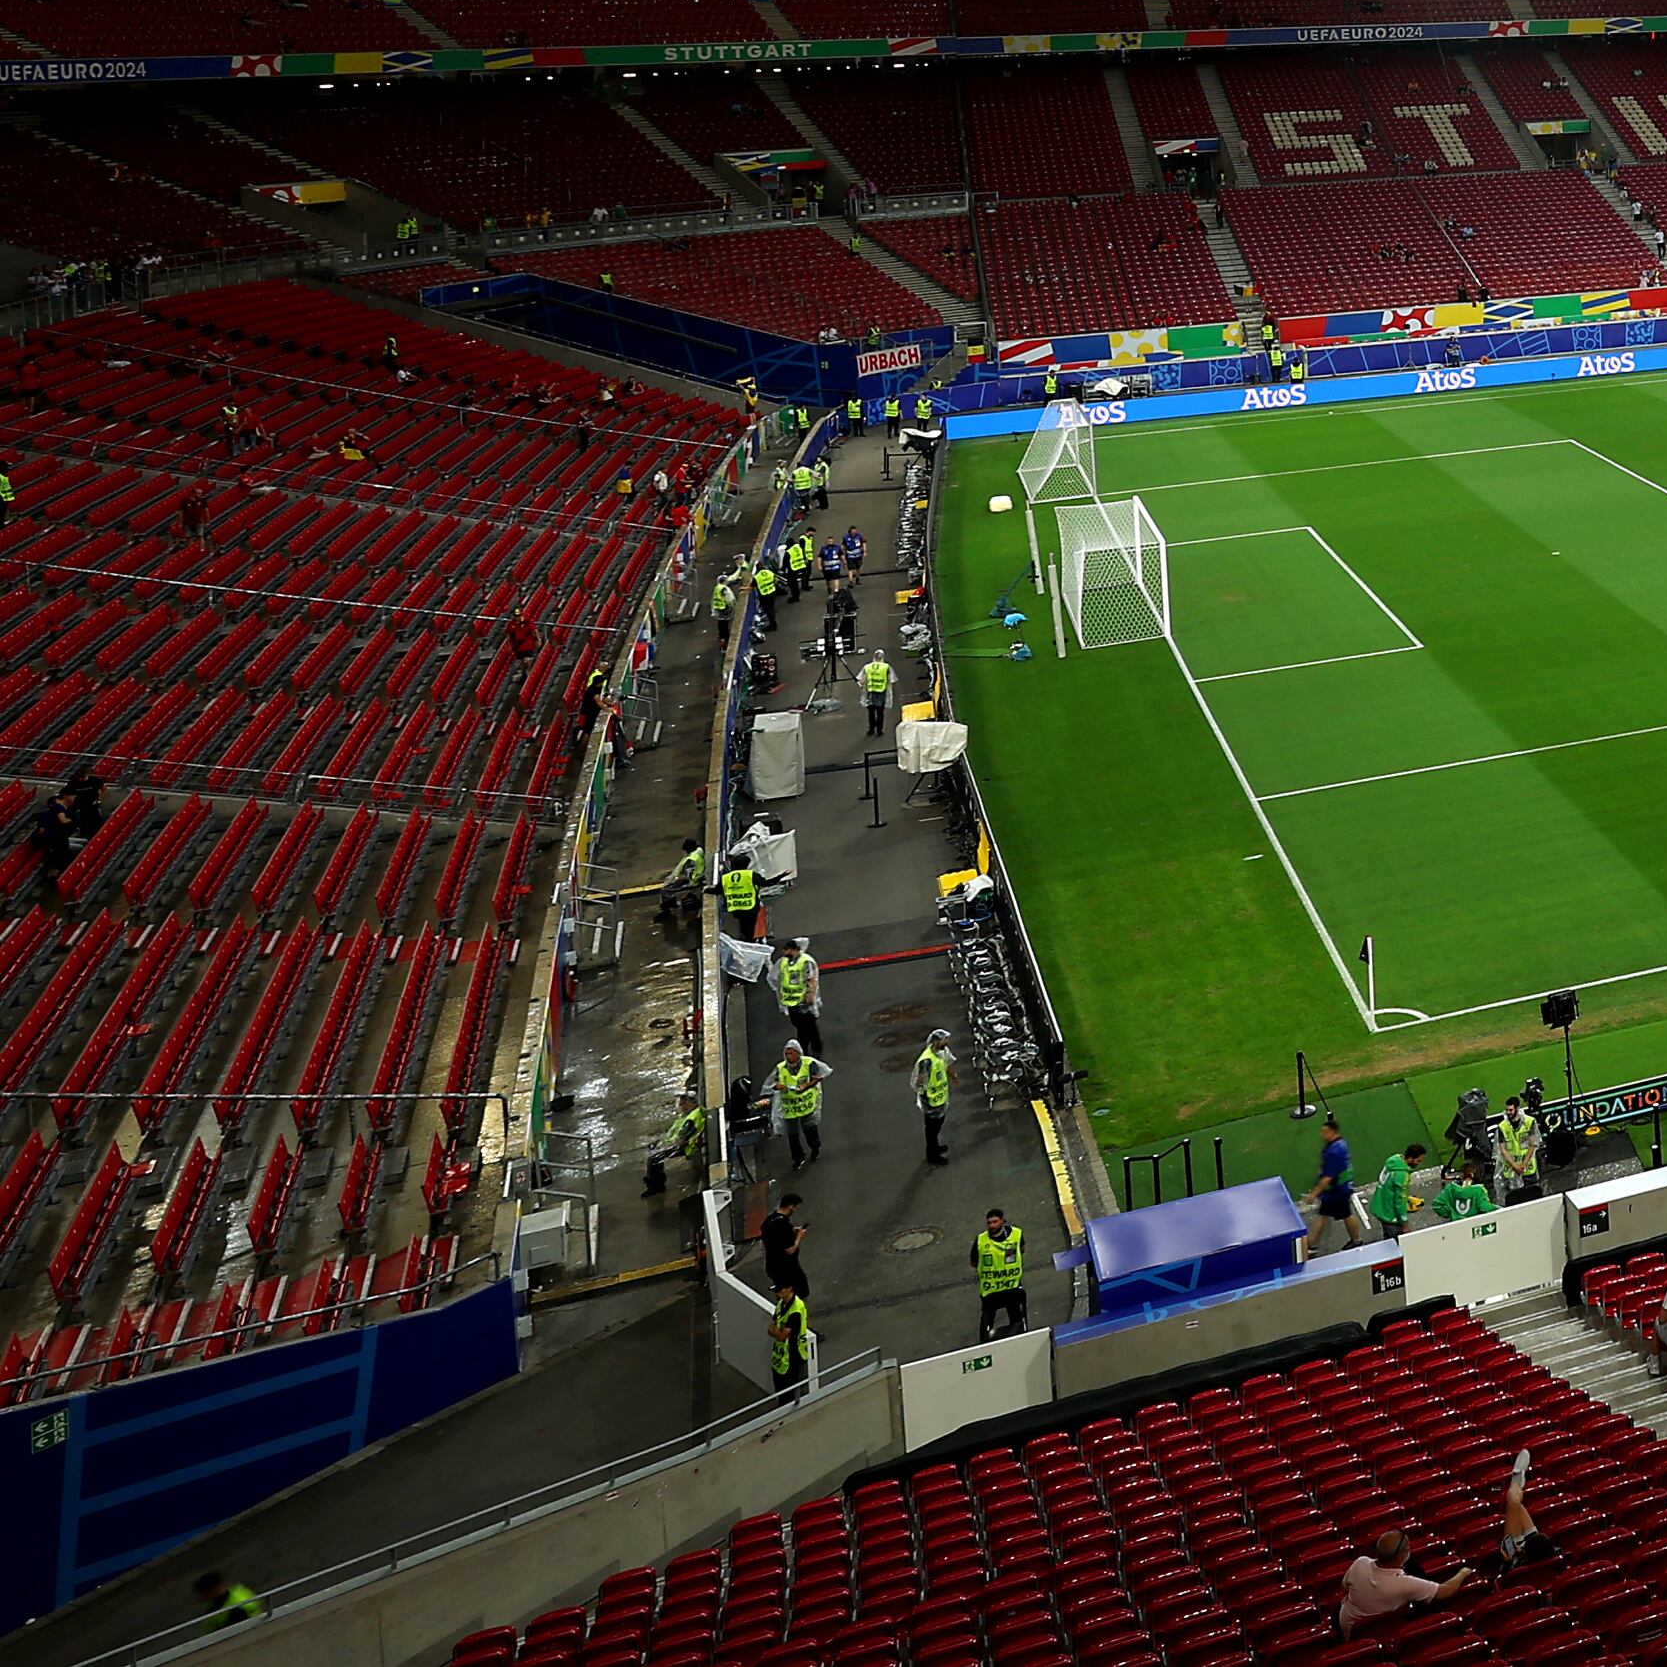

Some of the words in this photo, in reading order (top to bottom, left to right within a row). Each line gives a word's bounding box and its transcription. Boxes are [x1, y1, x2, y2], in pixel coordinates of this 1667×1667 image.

[664, 44, 812, 61] STUTTGART
[859, 347, 920, 374] URBACH
[1386, 1276, 1401, 1288] 16b
